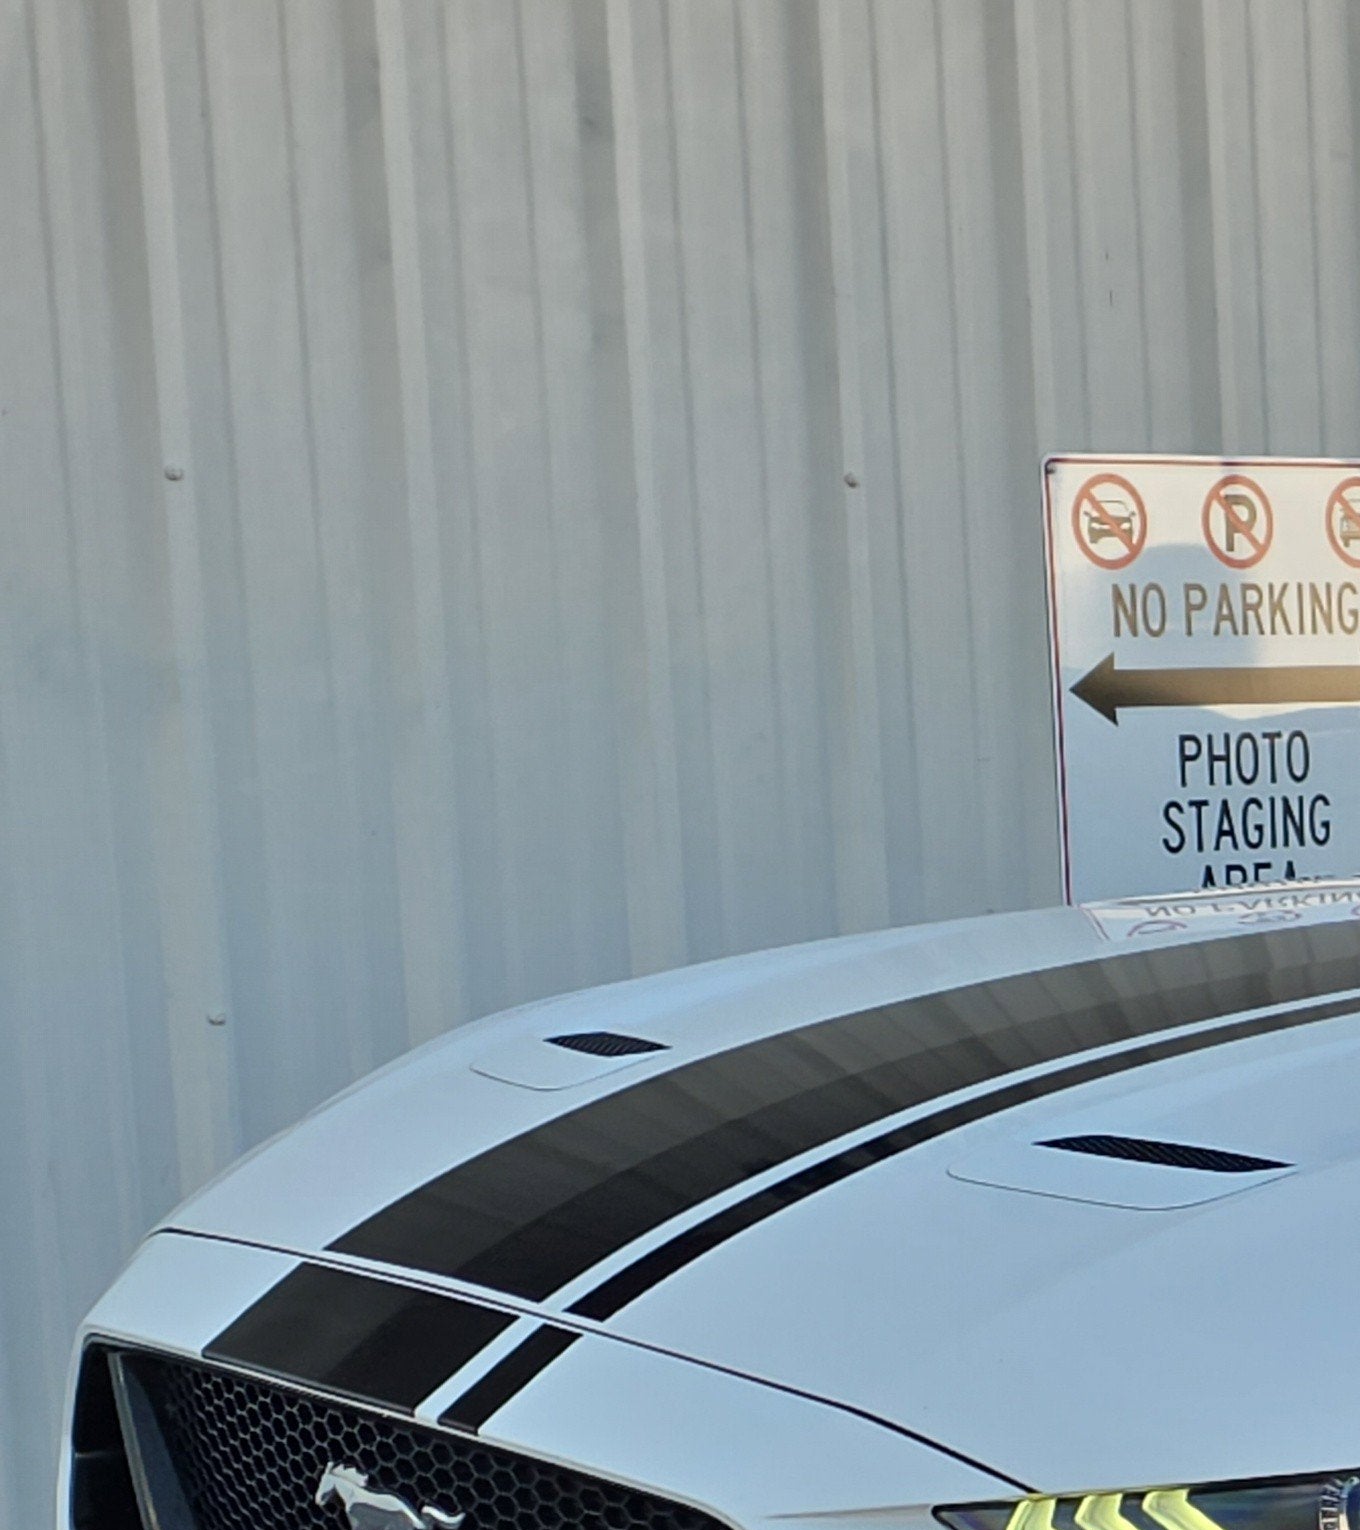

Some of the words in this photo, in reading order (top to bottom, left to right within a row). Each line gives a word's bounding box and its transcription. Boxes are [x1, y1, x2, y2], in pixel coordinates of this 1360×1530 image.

[1111, 581, 1167, 638] NO
[1183, 581, 1360, 637] PARKING
[1177, 730, 1311, 788] PHOTO
[1162, 793, 1332, 854] STAGING
